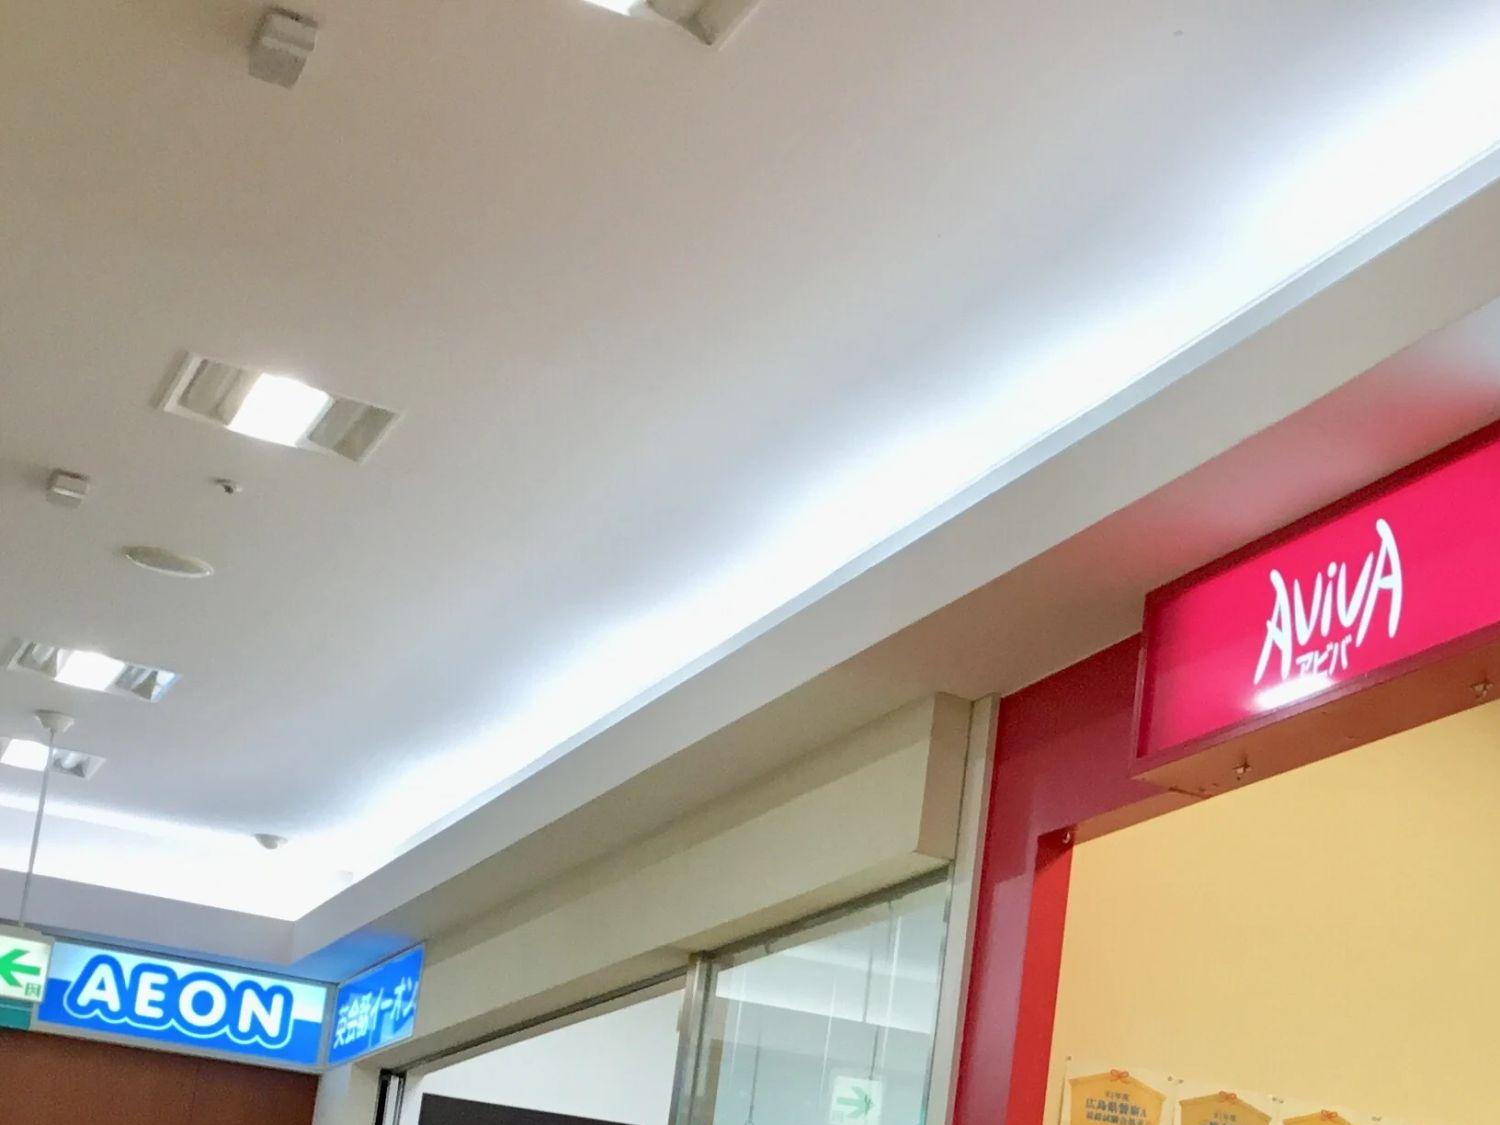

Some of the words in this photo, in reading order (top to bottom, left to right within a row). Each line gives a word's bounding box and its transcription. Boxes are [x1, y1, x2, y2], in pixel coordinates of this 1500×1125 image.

[1296, 635, 1354, 679] アビバ
[72, 955, 288, 1042] AEON
